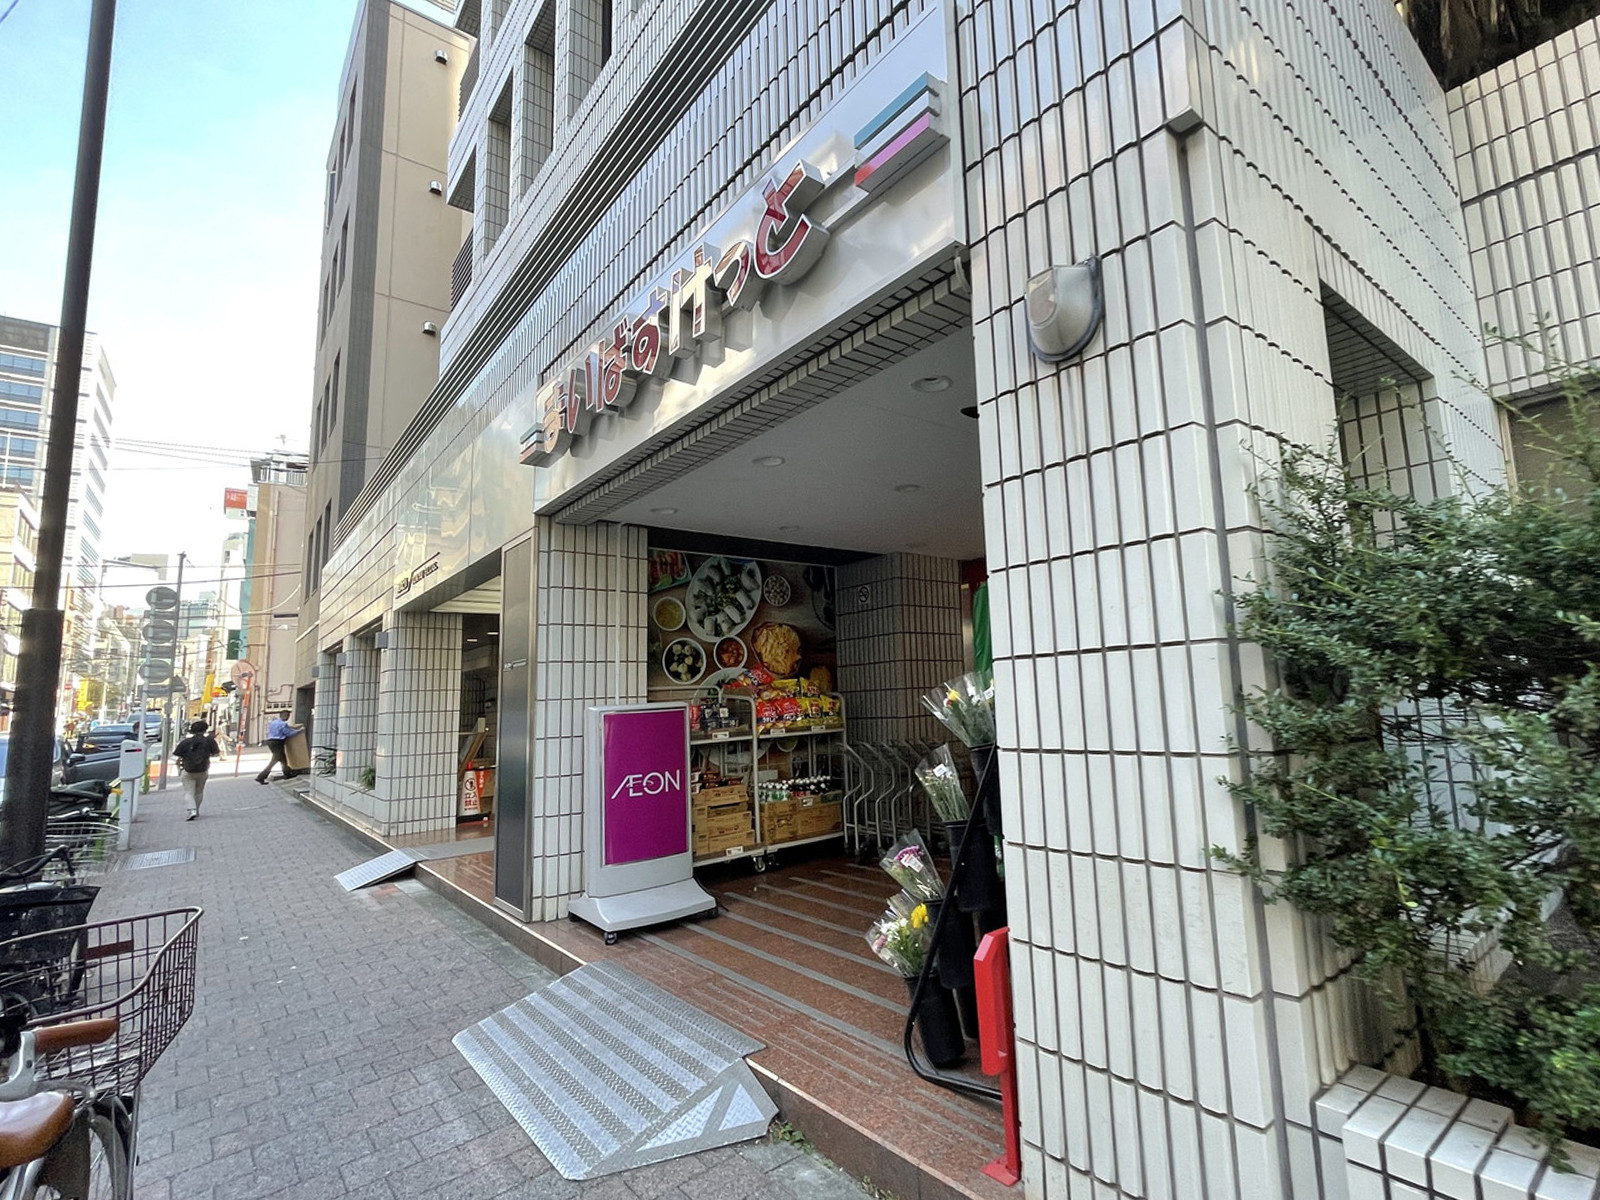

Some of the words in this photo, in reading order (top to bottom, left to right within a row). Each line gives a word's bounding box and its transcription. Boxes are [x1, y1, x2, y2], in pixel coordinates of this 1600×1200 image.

[542, 158, 816, 455] まいばすけっと
